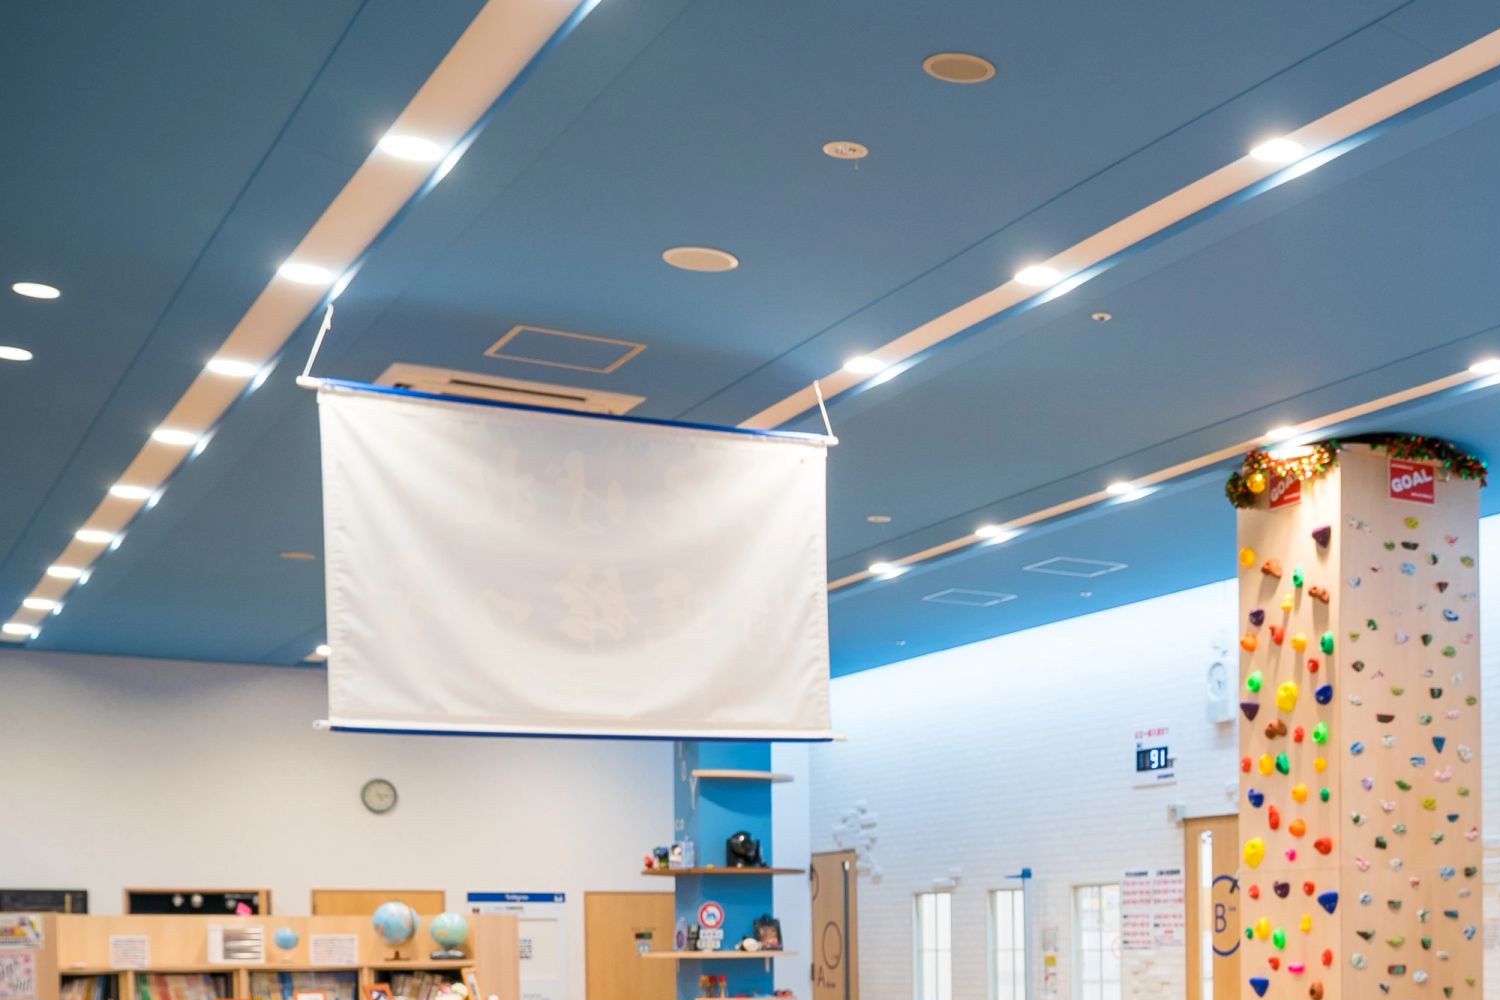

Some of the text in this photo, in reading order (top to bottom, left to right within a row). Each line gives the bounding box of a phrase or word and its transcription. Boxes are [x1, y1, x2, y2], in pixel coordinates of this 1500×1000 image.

[1271, 476, 1297, 502] GOA
[1391, 469, 1432, 492] GOAL
[1215, 903, 1227, 933] B
[817, 965, 826, 988] A
